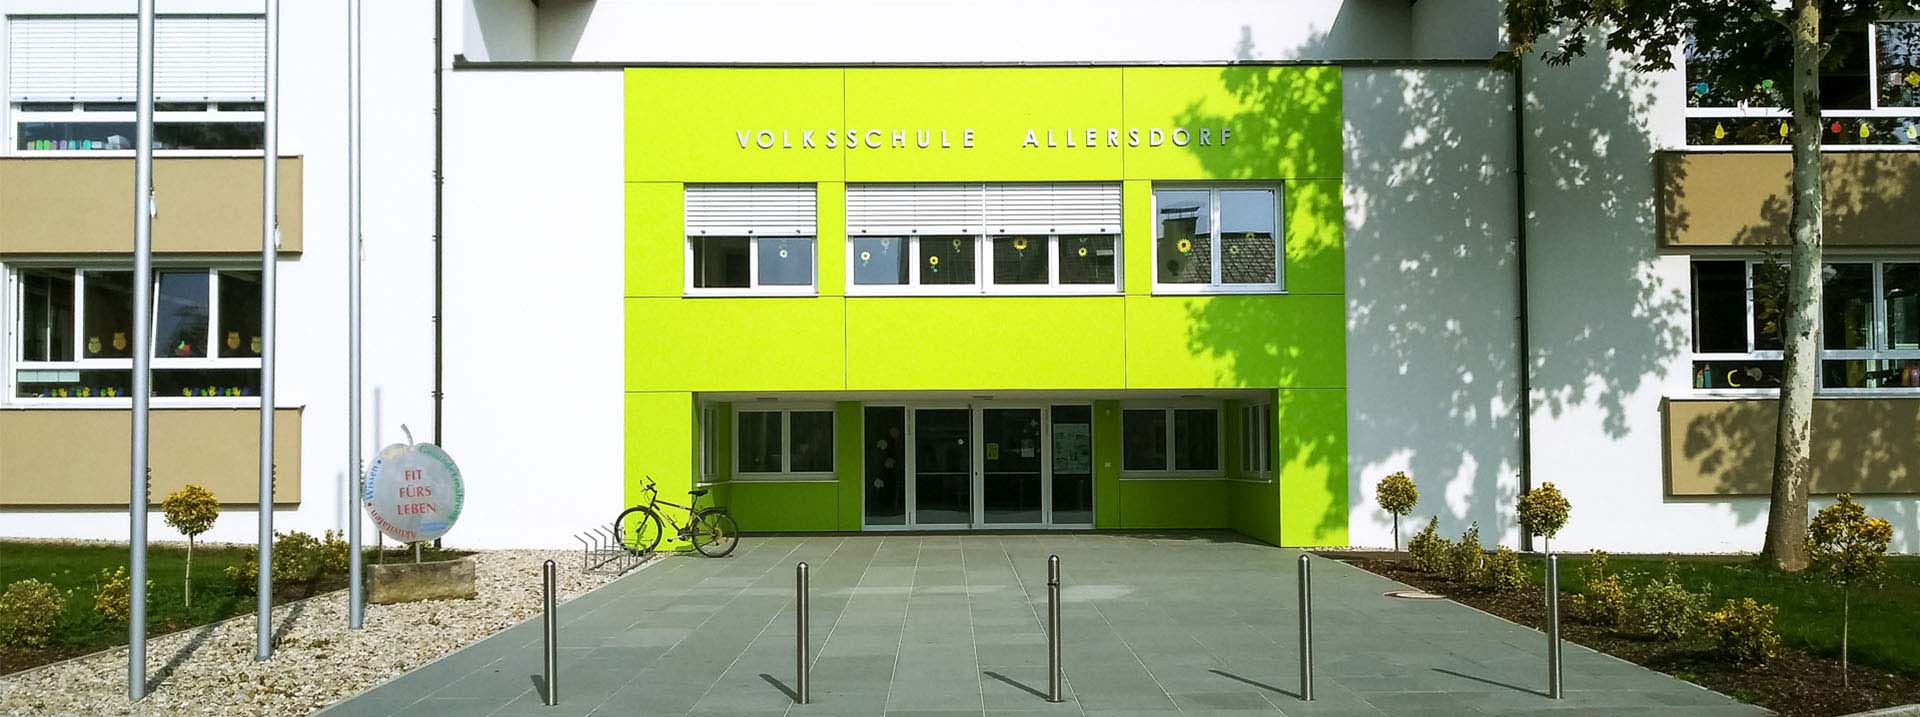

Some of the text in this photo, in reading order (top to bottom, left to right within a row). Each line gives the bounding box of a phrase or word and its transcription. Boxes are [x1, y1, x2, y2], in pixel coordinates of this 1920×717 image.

[736, 128, 1231, 149] VOLKSSCHULE ALLERSDORF
[405, 469, 422, 481] FIT
[399, 484, 433, 498] FÜRS
[397, 502, 436, 515] LEBEN
